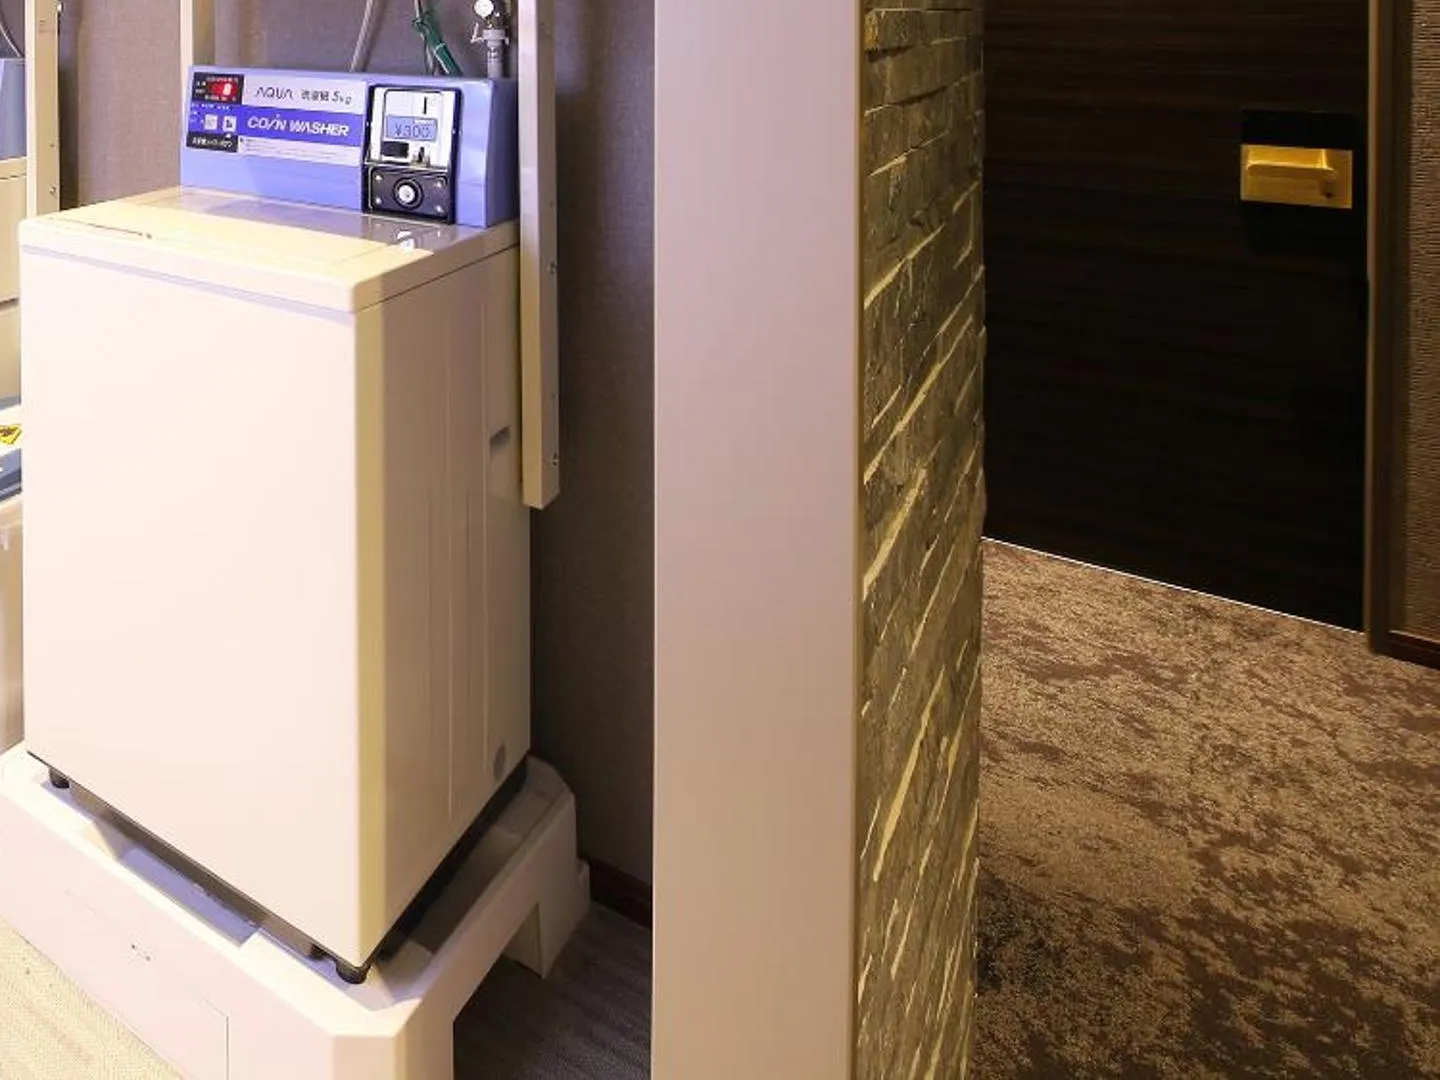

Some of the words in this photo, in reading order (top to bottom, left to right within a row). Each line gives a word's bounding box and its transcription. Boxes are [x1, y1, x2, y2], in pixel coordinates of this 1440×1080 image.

[255, 86, 294, 100] AQUA
[247, 113, 288, 132] COIN
[289, 118, 351, 137] WASHER
